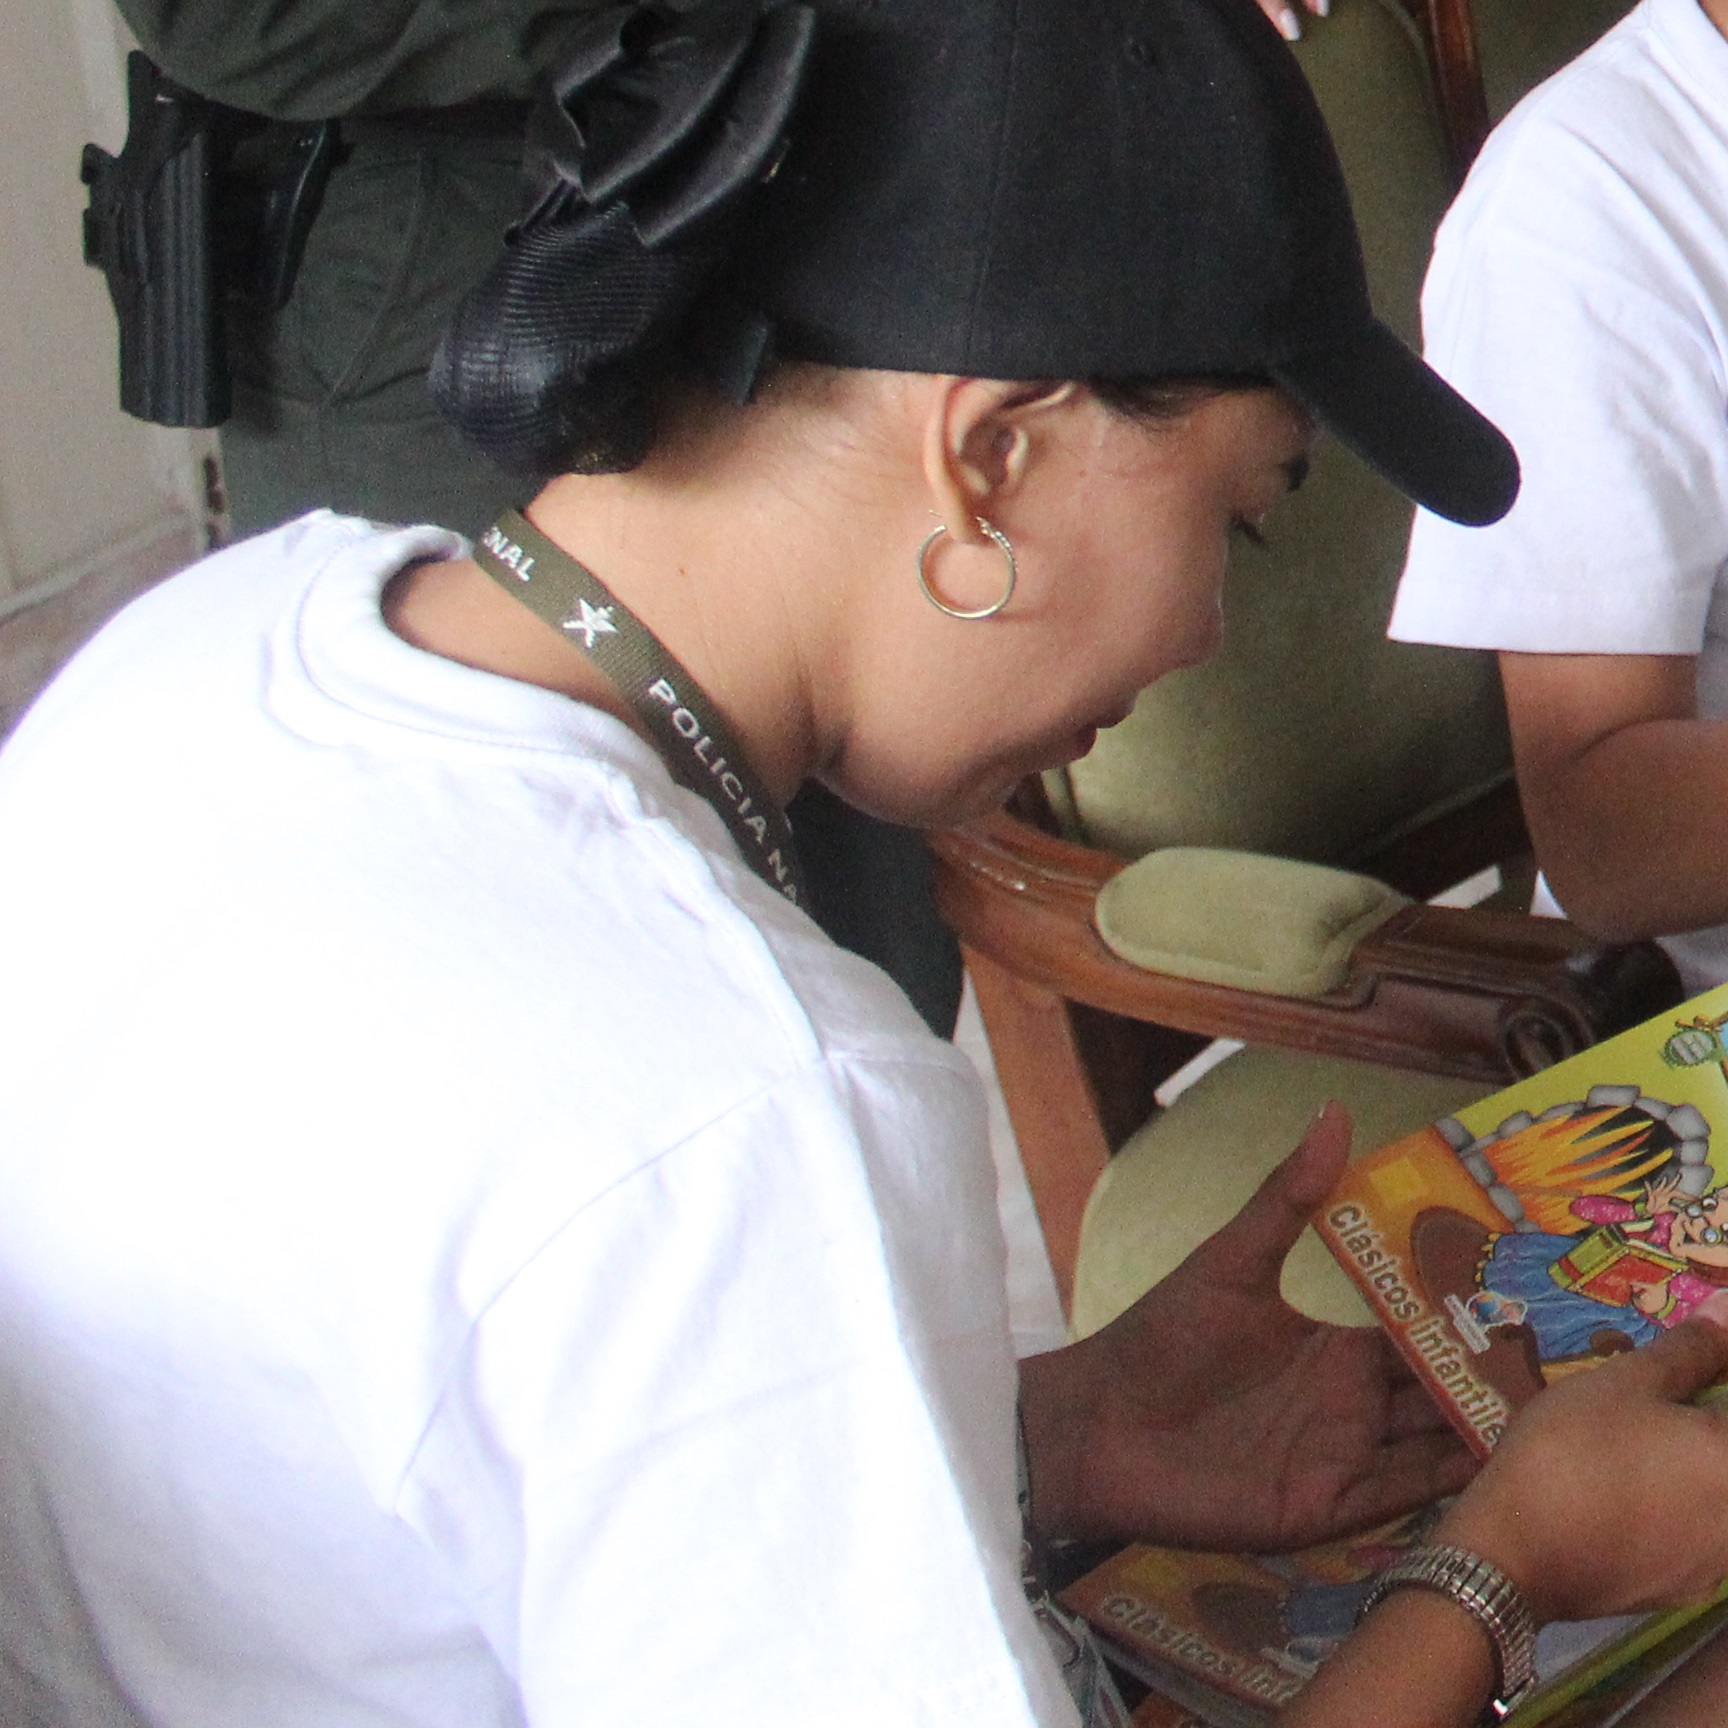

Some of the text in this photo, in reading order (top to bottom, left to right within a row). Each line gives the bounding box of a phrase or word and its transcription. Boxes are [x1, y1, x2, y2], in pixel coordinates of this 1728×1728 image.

[648, 678, 768, 844] POLICIA
[1328, 1203, 1421, 1322] Clásicos
[1407, 1315, 1509, 1447] infantile
